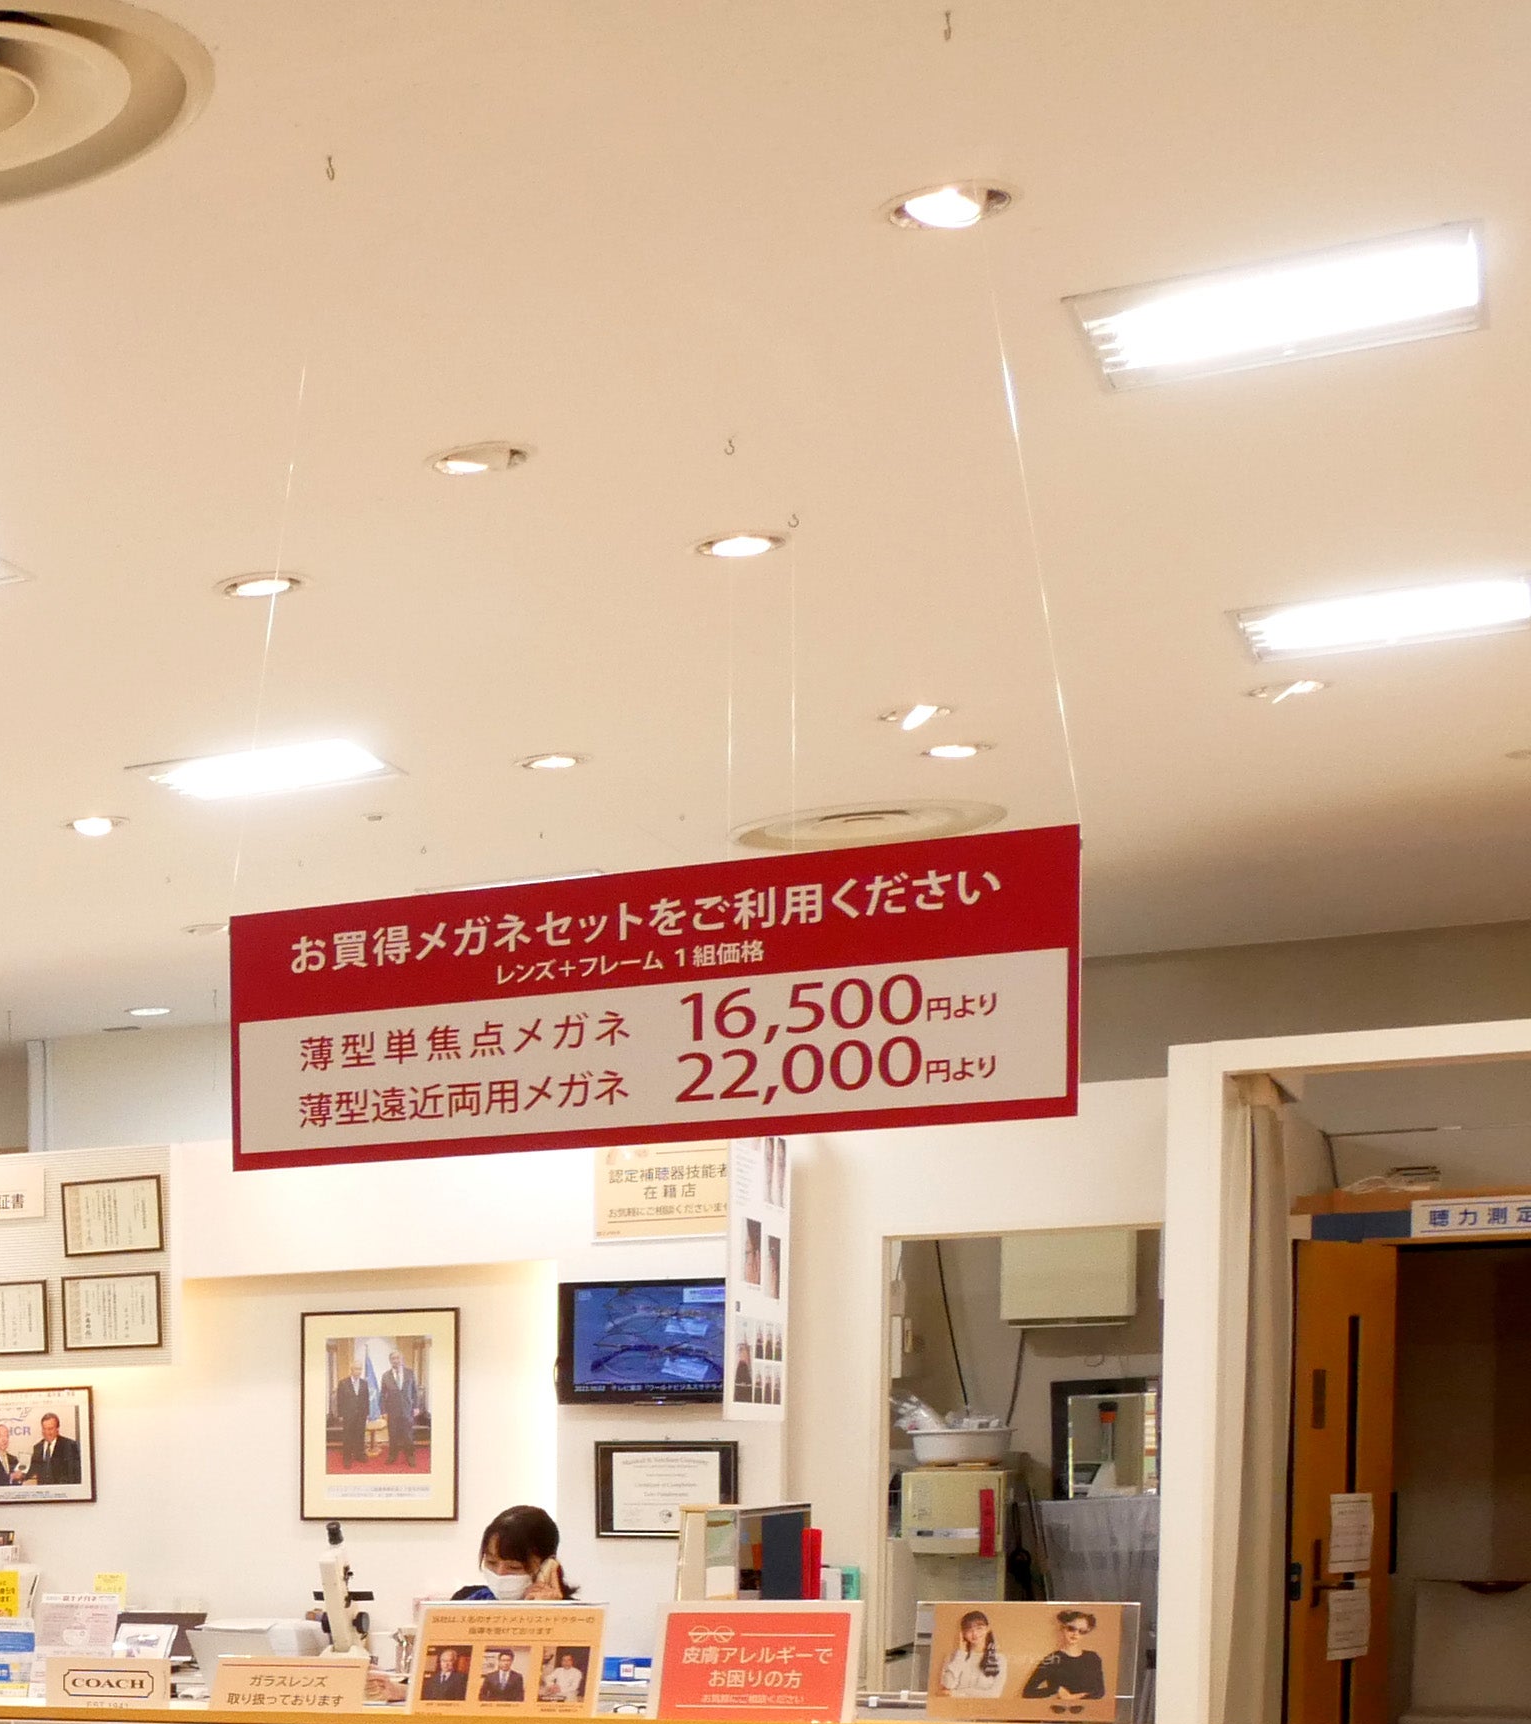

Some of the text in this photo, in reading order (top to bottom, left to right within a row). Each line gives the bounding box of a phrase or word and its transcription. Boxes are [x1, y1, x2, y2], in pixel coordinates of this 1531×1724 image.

[290, 870, 1002, 974] お買得メガネセットをご利用ください
[299, 1010, 631, 1072] 薄型単焦点メガネ
[298, 1069, 630, 1129] 薄型遠近両用メガネ
[682, 1645, 834, 1666] 皮膚アレルギーで
[71, 1678, 145, 1689] COACH
[249, 1675, 328, 1688] ガラスレンズ
[707, 1669, 803, 1689] お困りの方
[226, 1692, 345, 1707] 取り扱っております
